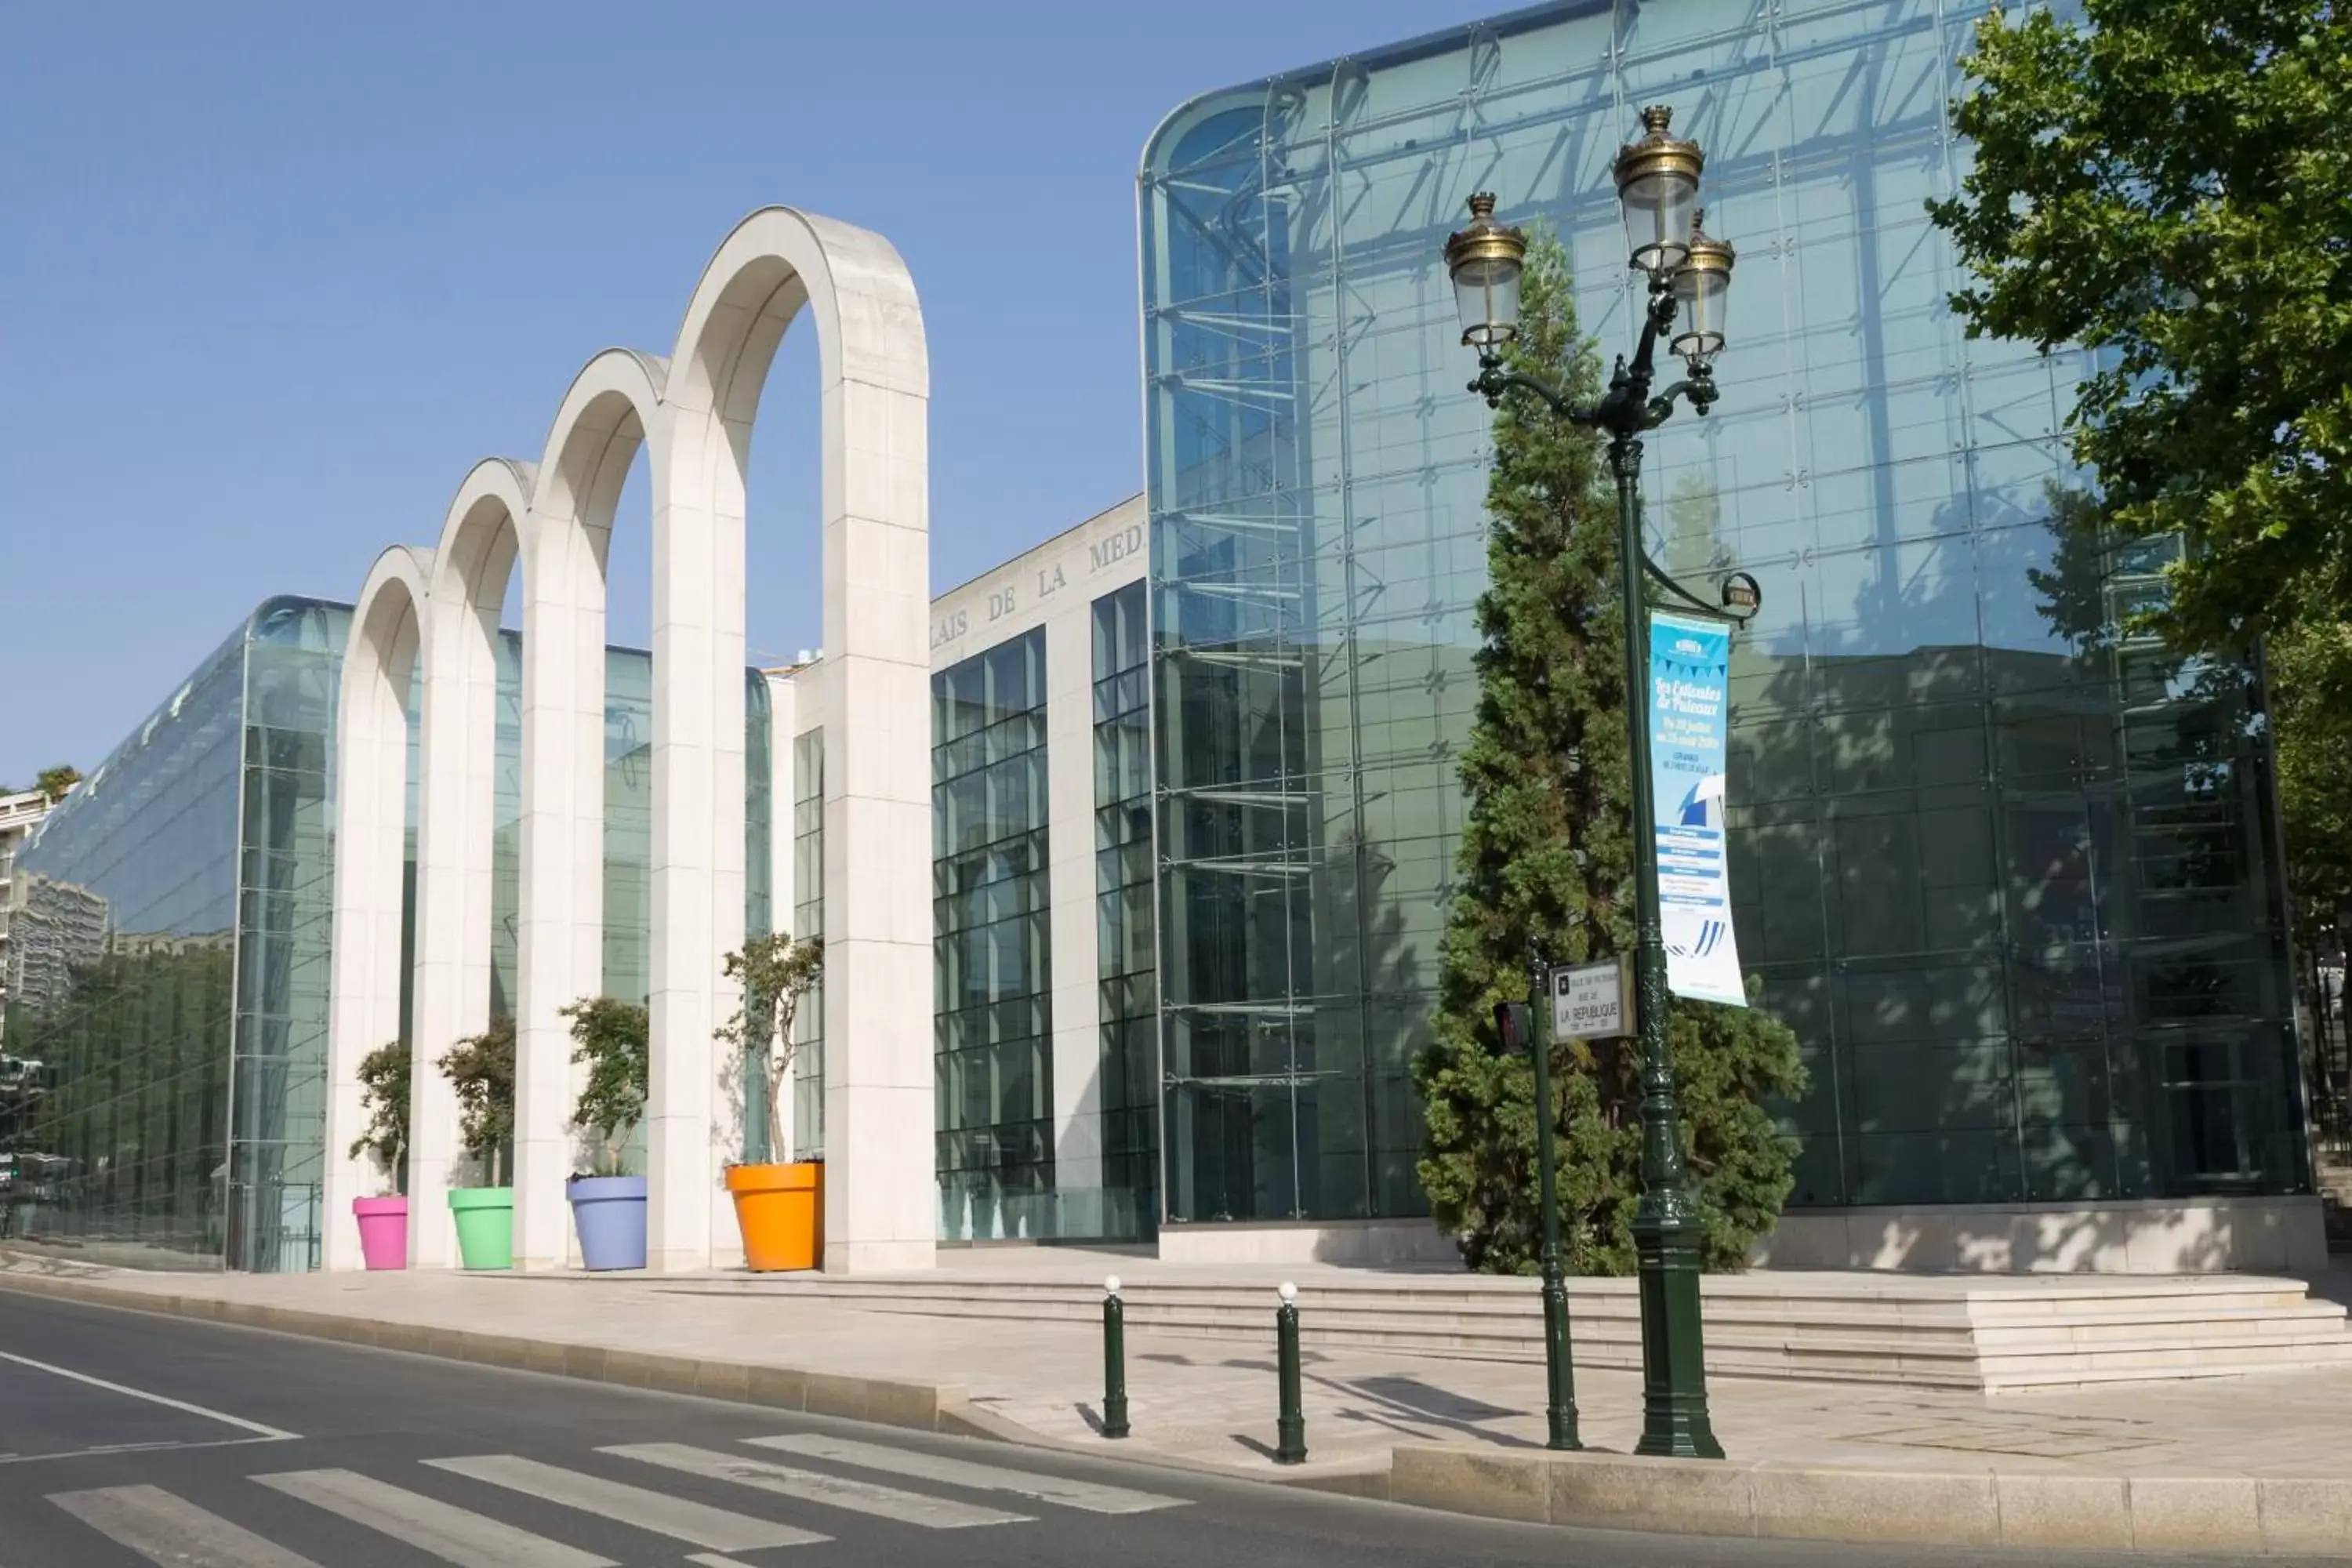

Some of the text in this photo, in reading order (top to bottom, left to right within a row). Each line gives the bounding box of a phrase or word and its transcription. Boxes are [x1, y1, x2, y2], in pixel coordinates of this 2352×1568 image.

[988, 586, 1016, 622] DE
[1037, 563, 1068, 598] LA
[1560, 1010, 1570, 1022] LA
